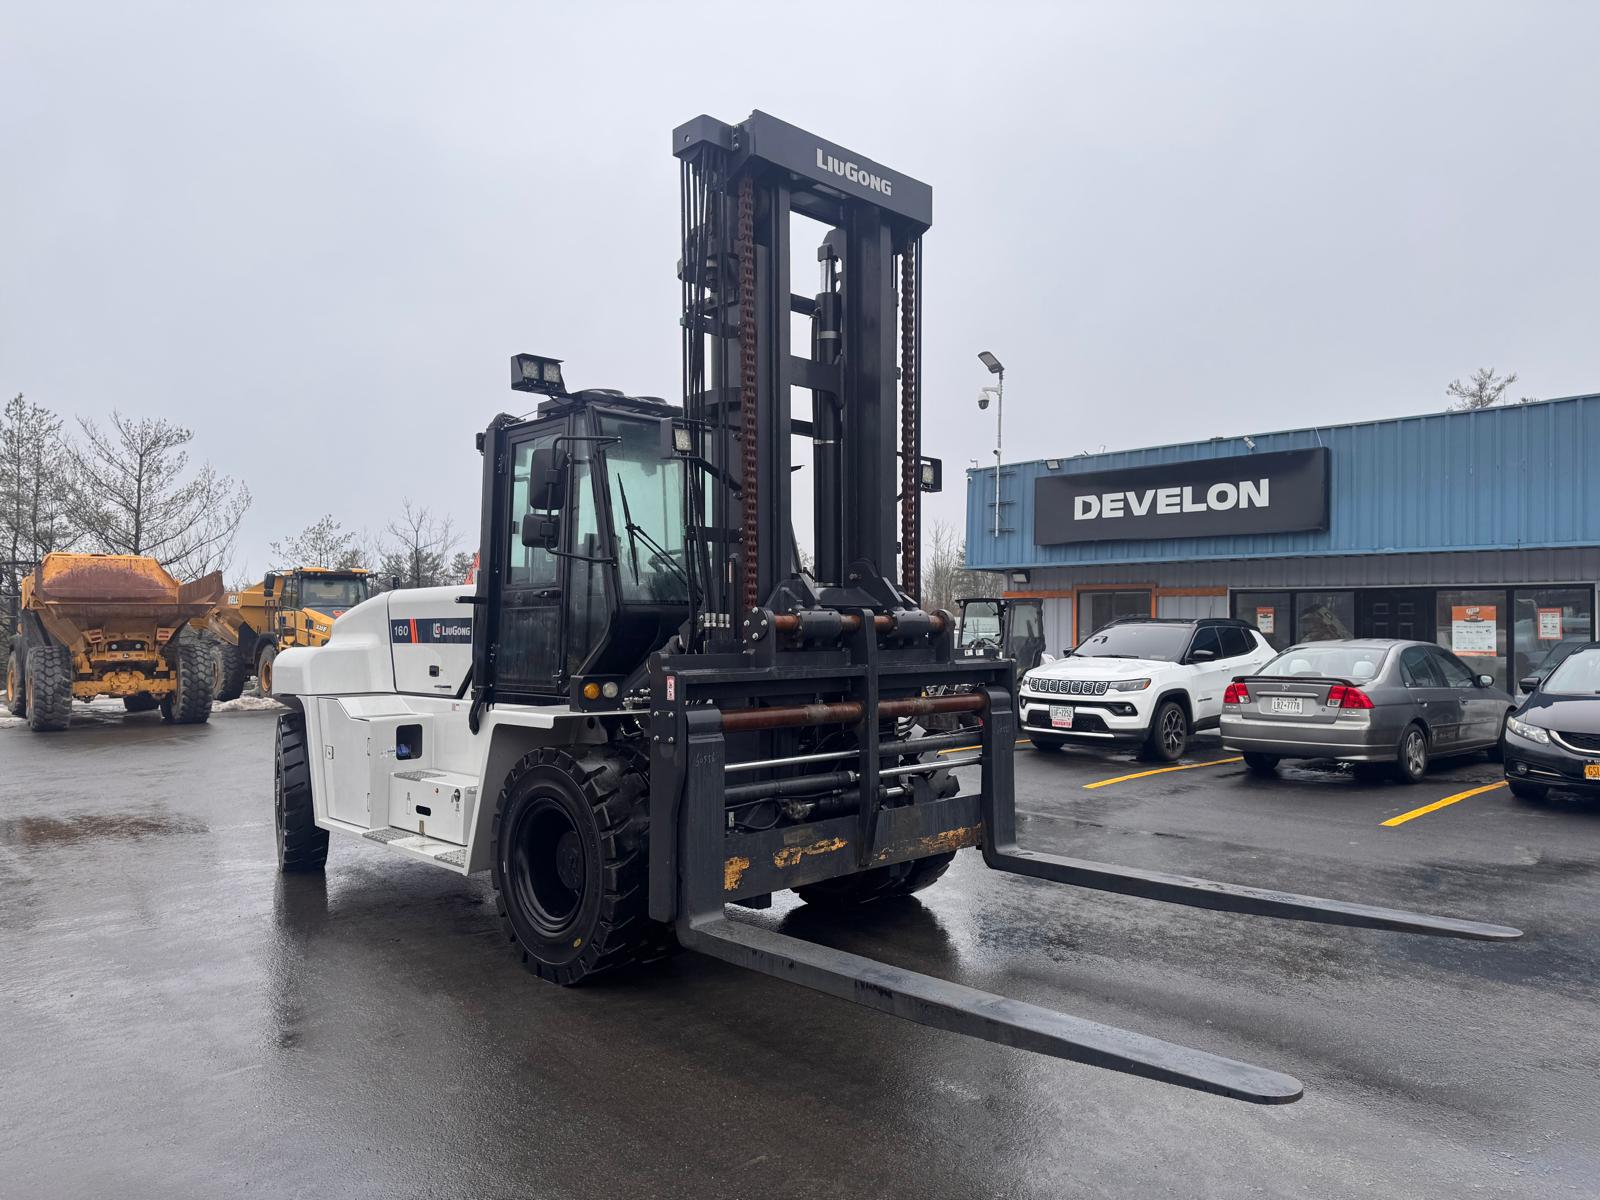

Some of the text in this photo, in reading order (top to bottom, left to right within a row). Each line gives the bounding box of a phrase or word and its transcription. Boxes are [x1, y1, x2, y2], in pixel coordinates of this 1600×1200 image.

[816, 147, 892, 197] LIUGONG
[1074, 478, 1270, 521] DEVELON
[394, 625, 409, 636] 160
